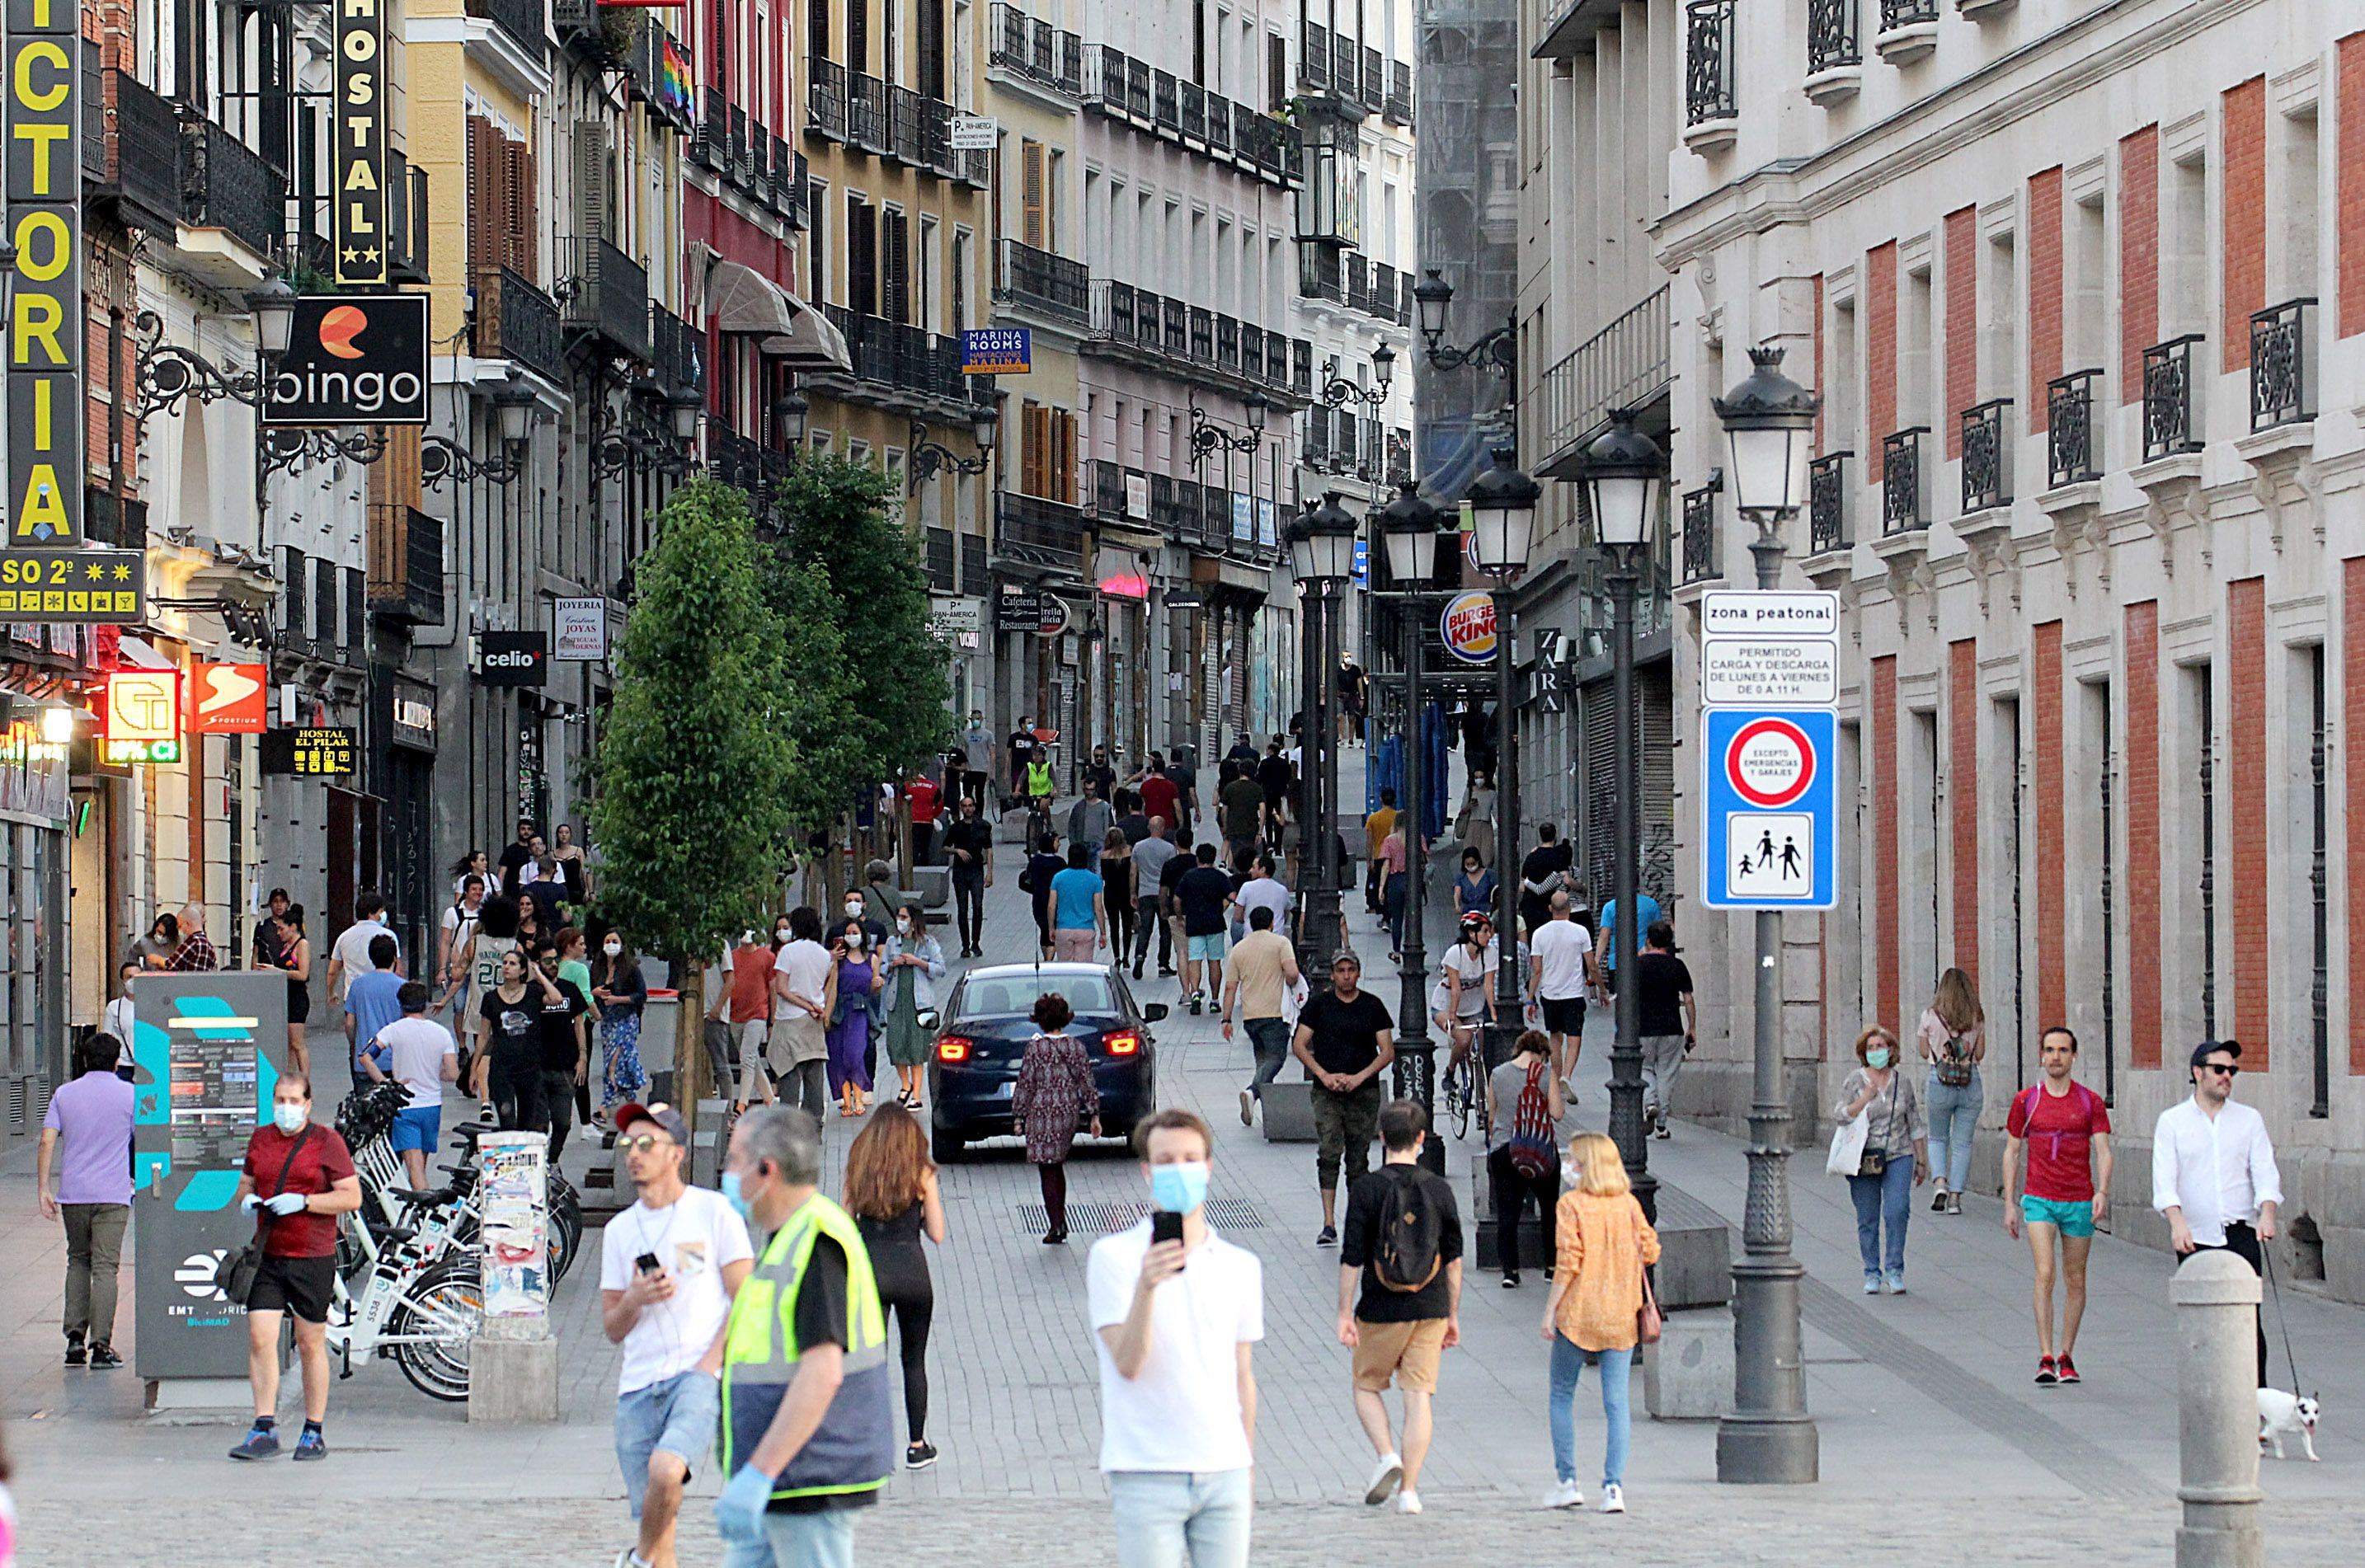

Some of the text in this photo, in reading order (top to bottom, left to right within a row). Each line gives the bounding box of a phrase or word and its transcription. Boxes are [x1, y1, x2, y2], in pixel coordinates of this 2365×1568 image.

[970, 331, 1022, 340] MARINA
[970, 340, 1022, 350] ROOMS
[271, 362, 421, 411] bingo
[558, 601, 601, 612] JOYERIA
[1449, 604, 1497, 630] BURGE
[1711, 607, 1831, 622] zona peatonal
[565, 625, 596, 635] JOYAS
[999, 620, 1039, 630] Restaurante
[1739, 648, 1801, 657] PERMITIDO
[1711, 660, 1829, 669] CARGA Y DESCARGA
[1540, 631, 1559, 711] ZARA
[1710, 673, 1830, 682] DE LUNES A VIERNES
[1737, 685, 1753, 694] DE
[1766, 685, 1773, 694] A
[1777, 685, 1788, 694] 11
[200, 714, 257, 726] SPORTIUM
[299, 730, 346, 739] HOSTAL
[168, 1306, 195, 1315] EMT
